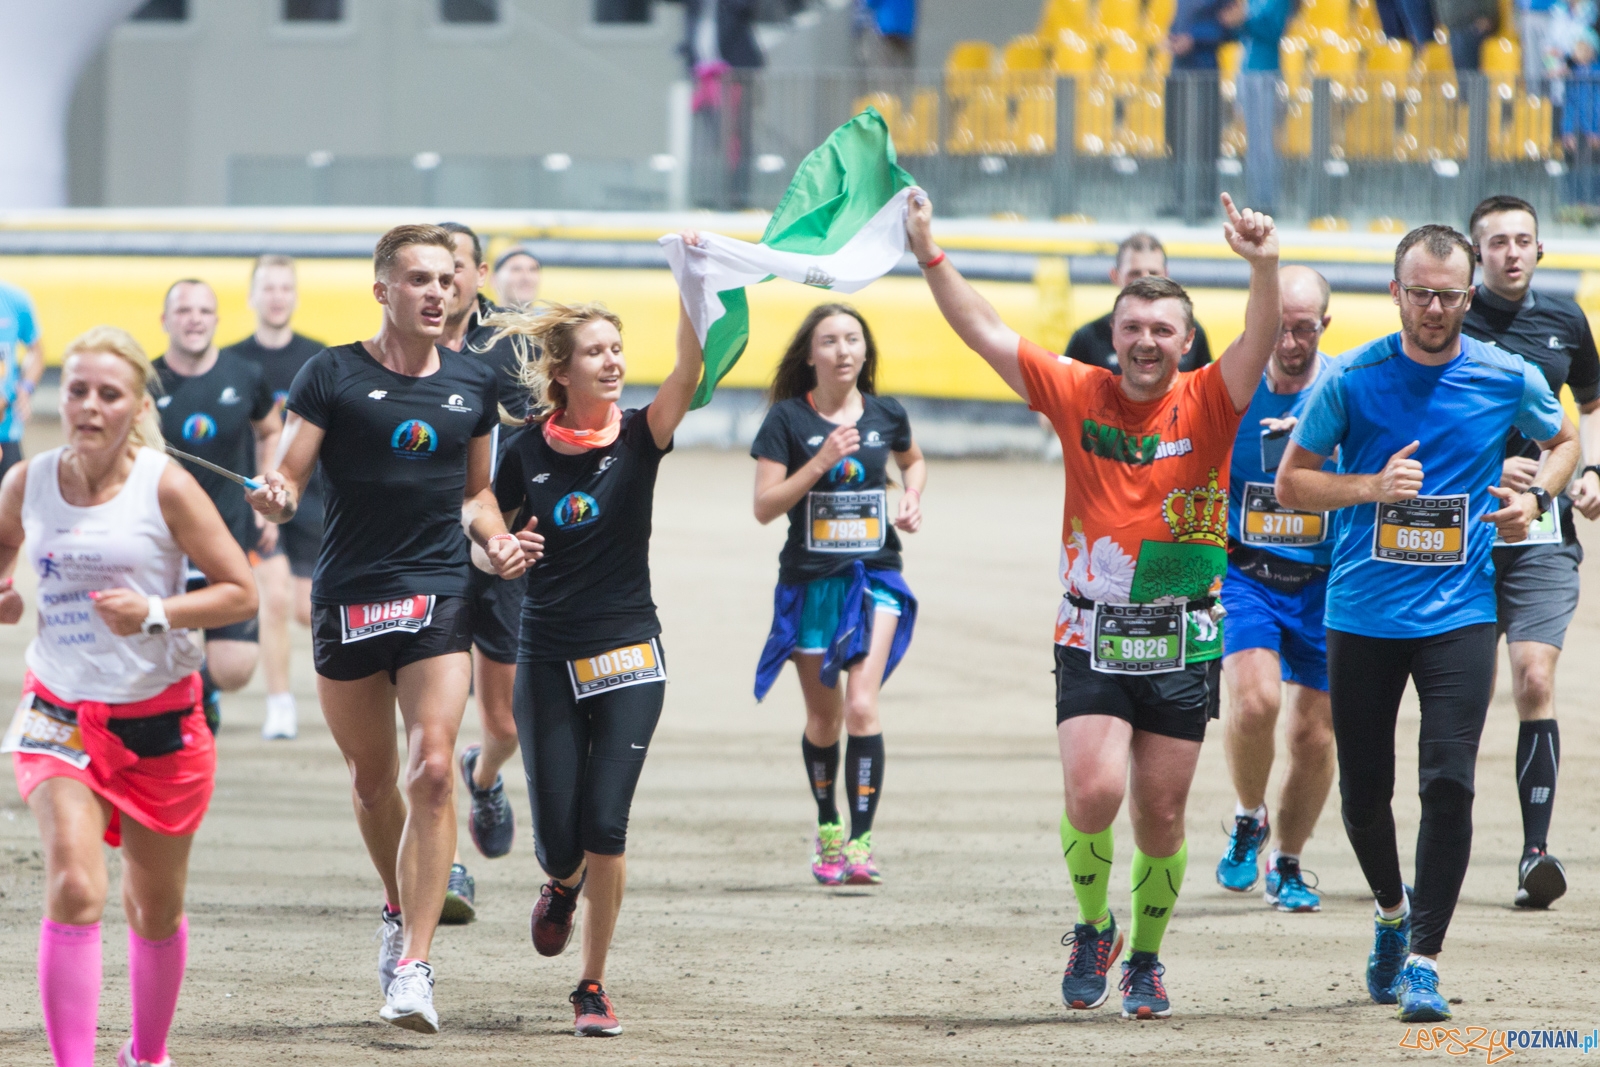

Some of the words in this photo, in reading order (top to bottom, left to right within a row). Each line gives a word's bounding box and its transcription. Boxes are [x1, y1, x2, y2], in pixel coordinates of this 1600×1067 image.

[532, 473, 551, 484] 4F
[828, 520, 867, 539] 7925
[1262, 514, 1304, 535] 3710
[1396, 528, 1445, 551] 6639
[362, 598, 414, 624] 10159
[1121, 637, 1168, 660] 9826
[589, 647, 645, 677] 10158
